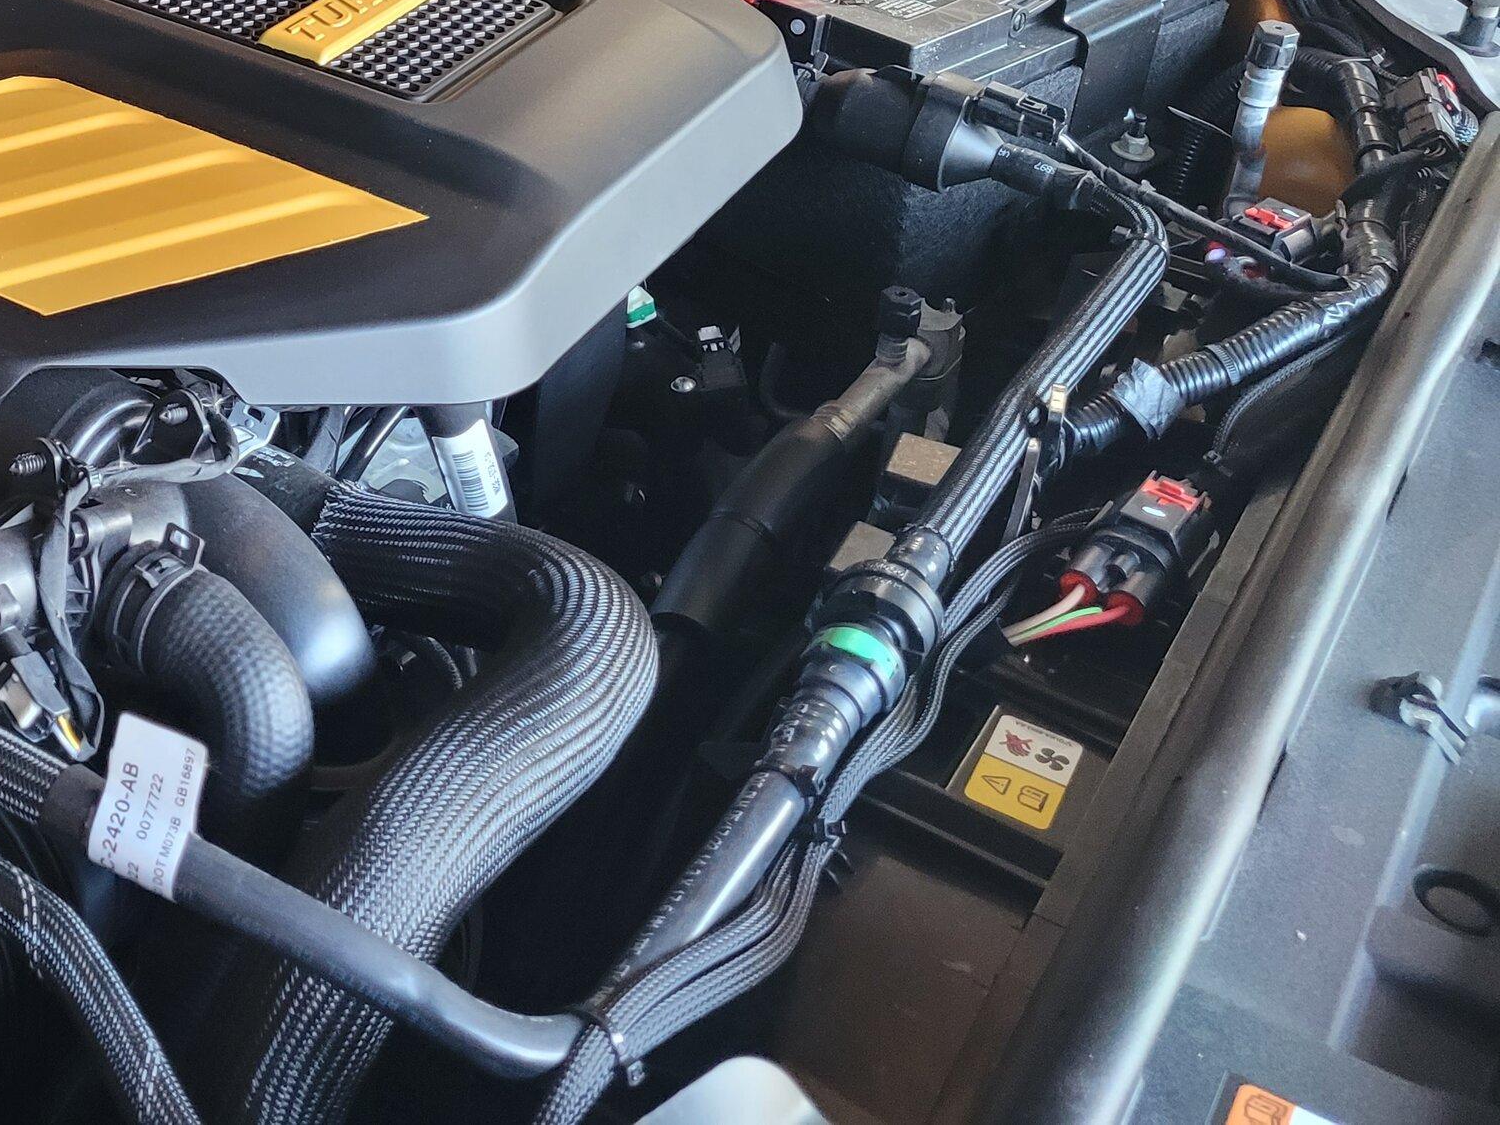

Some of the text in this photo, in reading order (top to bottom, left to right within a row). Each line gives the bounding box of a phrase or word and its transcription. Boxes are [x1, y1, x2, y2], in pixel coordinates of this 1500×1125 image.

[136, 773, 165, 841] 0077722
[160, 816, 182, 858] M073B
[174, 747, 196, 807] GB16897
